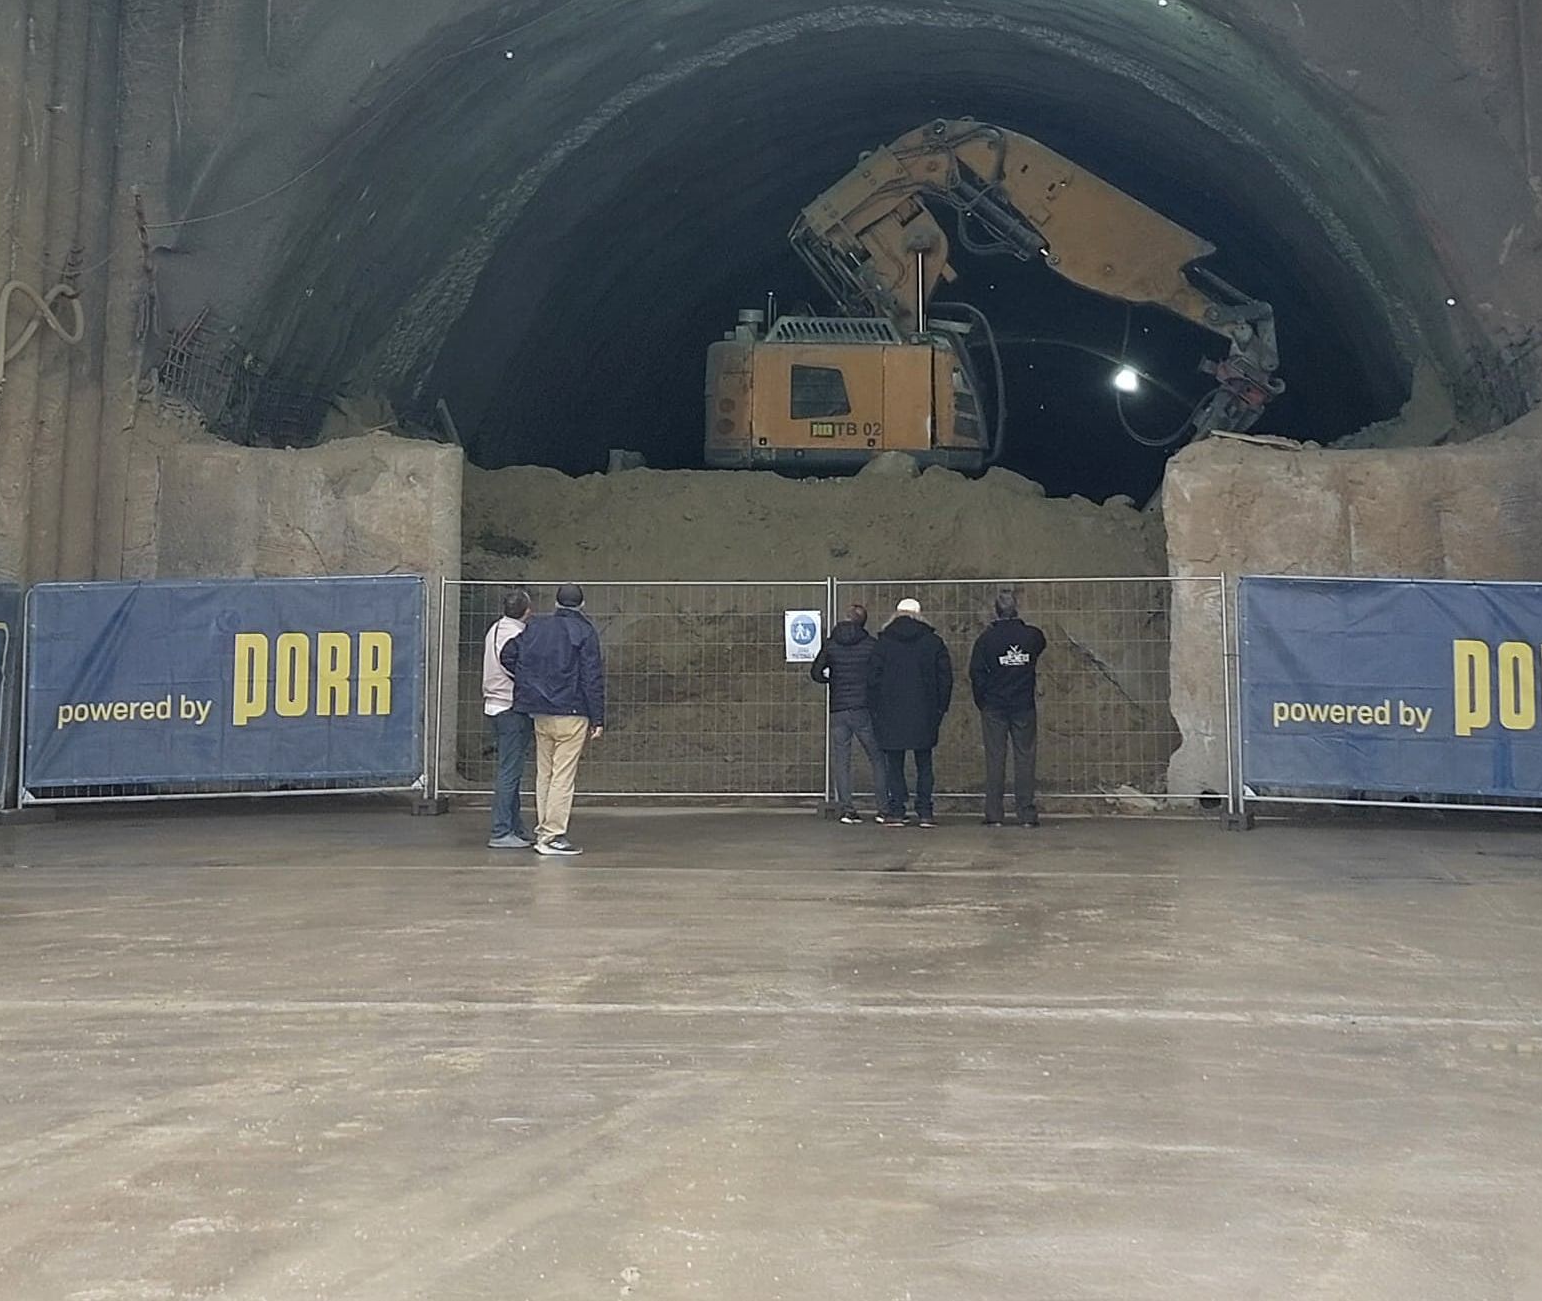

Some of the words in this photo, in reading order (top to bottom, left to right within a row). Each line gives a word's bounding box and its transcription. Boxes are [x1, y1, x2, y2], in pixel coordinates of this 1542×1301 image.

[863, 422, 882, 436] 02
[233, 631, 392, 726] PORR
[58, 695, 172, 729] powered
[179, 694, 212, 726] by
[1273, 699, 1390, 728] powered
[1399, 700, 1433, 732] by
